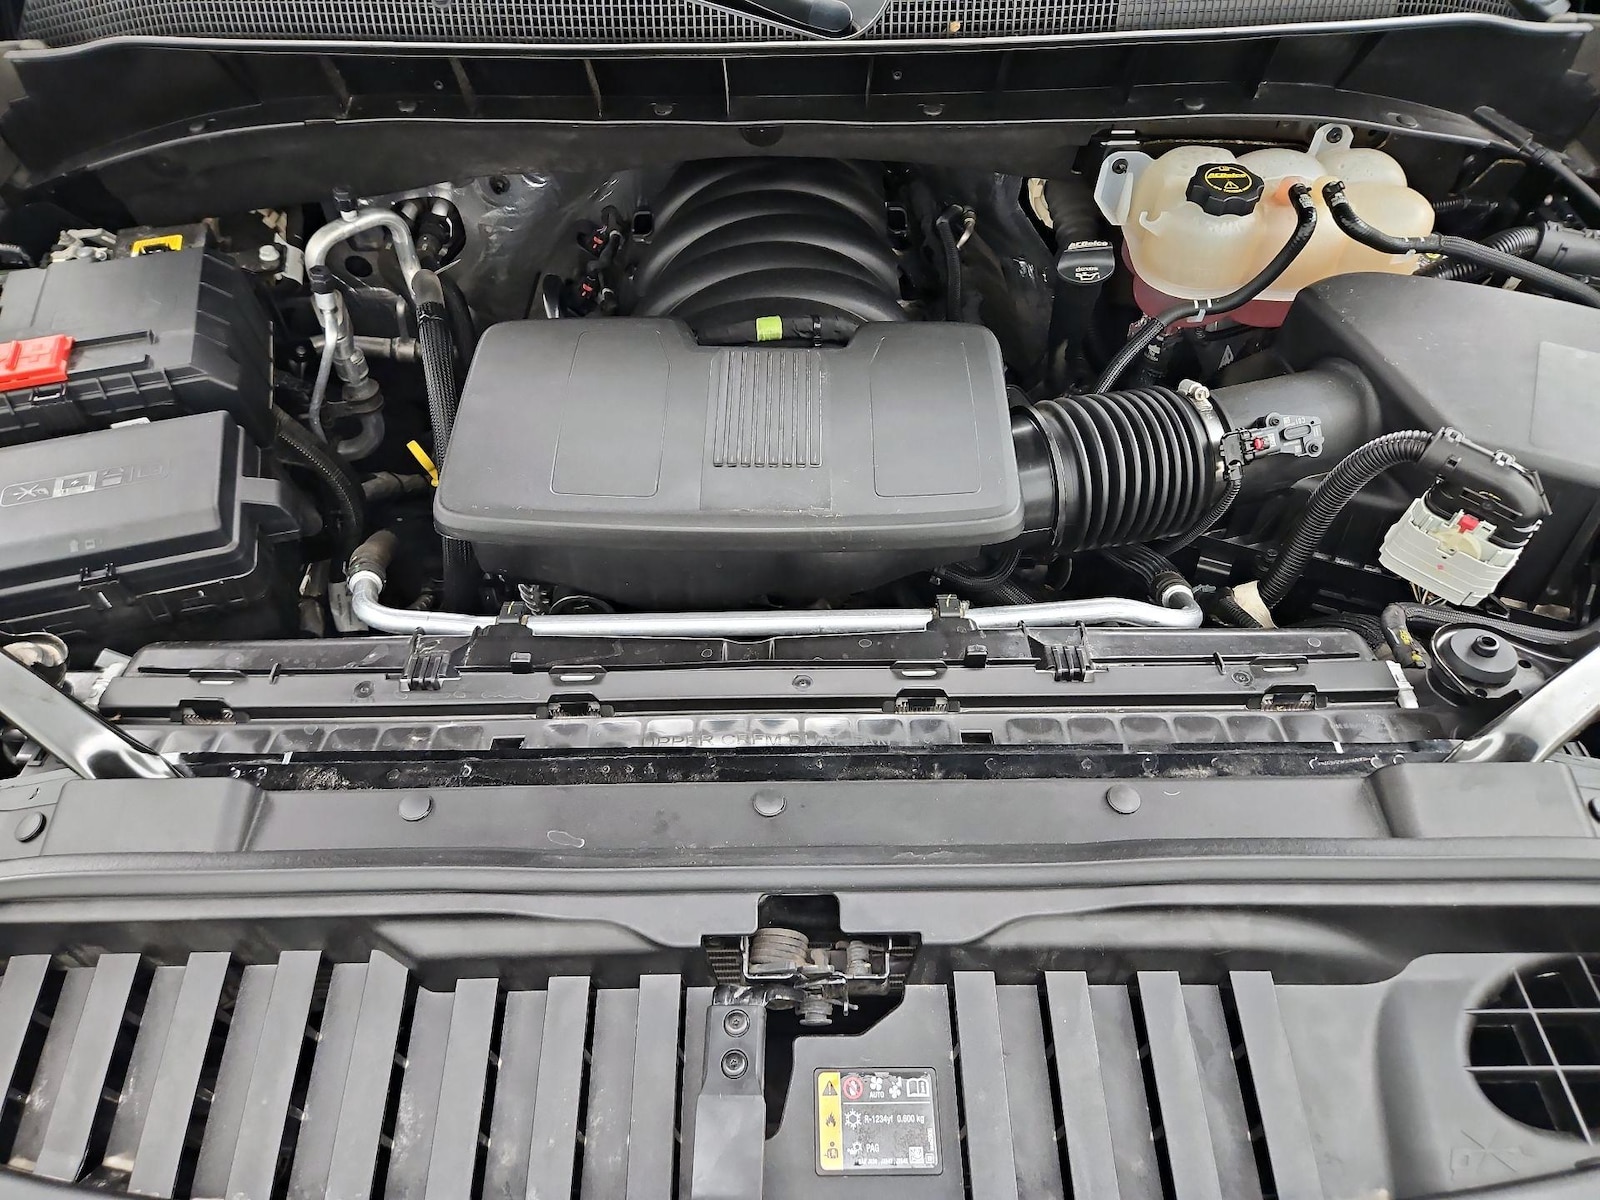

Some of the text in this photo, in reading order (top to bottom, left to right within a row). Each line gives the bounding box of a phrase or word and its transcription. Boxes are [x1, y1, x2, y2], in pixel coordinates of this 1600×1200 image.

[1068, 241, 1108, 249] ACDelco
[864, 1114, 893, 1124] R-1234yf
[916, 1114, 924, 1124] kg
[866, 1143, 879, 1153] PAG
